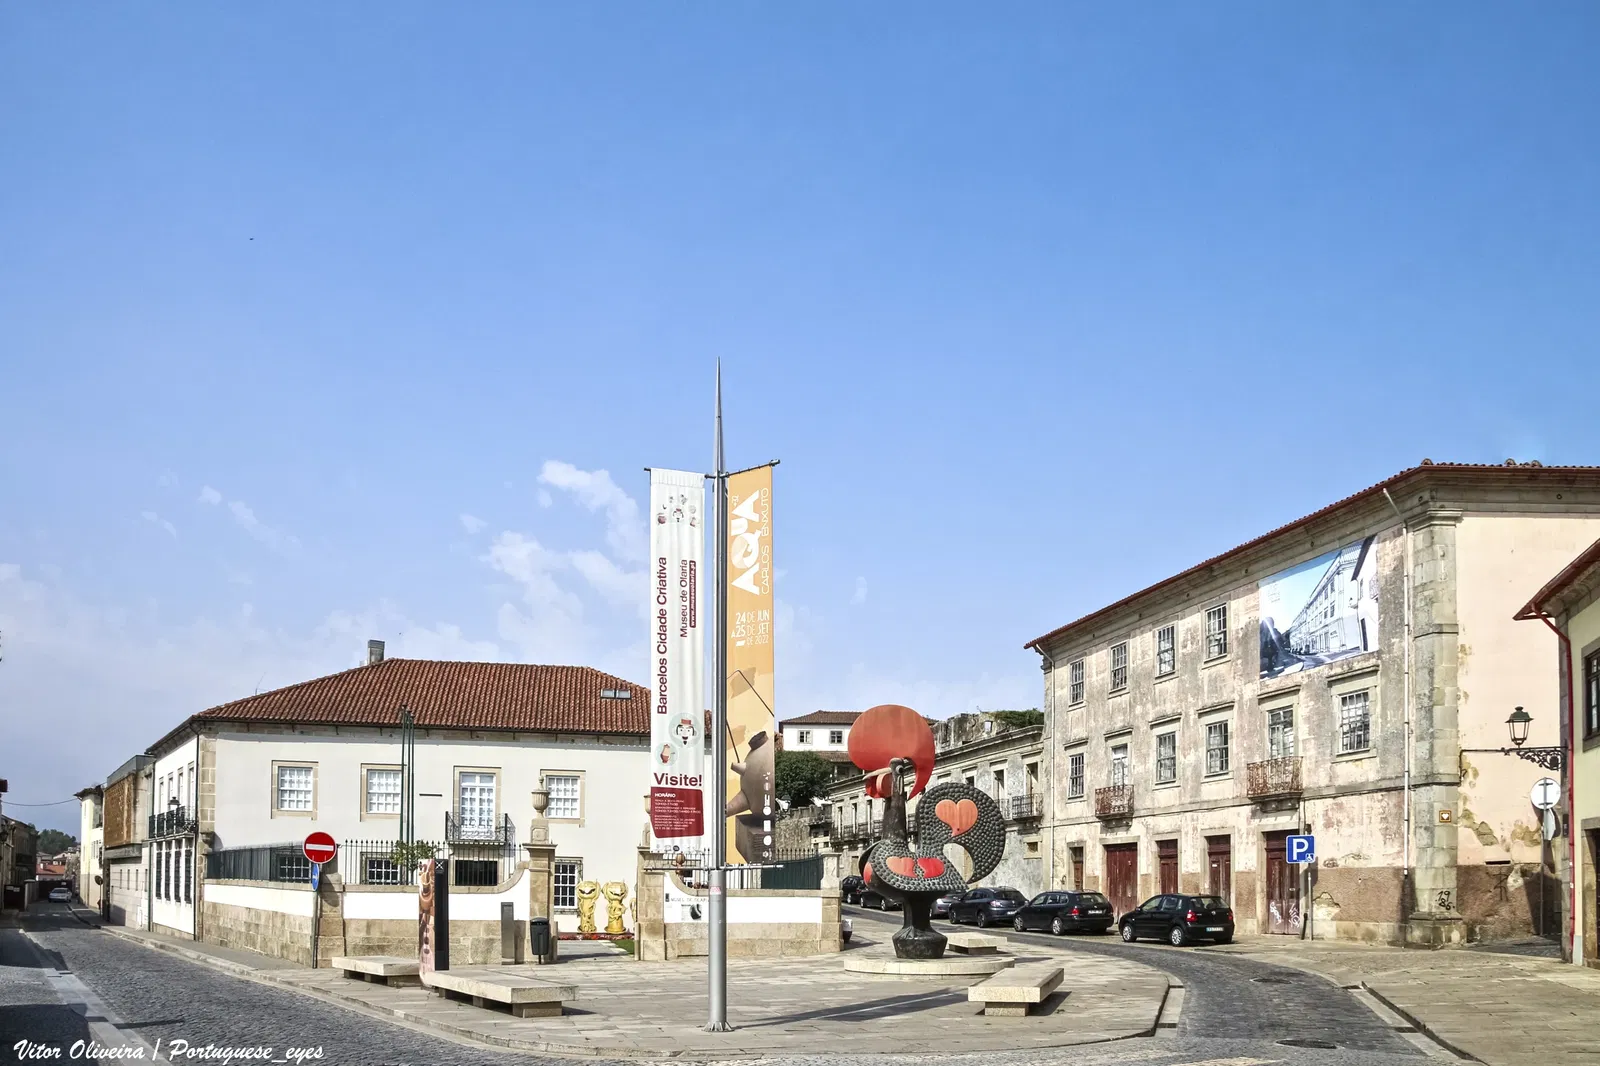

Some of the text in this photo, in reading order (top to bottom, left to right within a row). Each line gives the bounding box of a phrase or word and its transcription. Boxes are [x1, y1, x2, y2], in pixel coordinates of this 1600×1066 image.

[761, 545, 770, 595] CARLOS
[680, 559, 688, 638] Museu de Olaria
[735, 608, 770, 625] 24 DE JUN
[656, 557, 668, 715] Barcelos Cidade Criativa
[735, 624, 746, 638] 25
[746, 624, 756, 636] DE
[758, 622, 770, 635] SET
[754, 634, 769, 645] 2022
[653, 772, 703, 787] Visite!
[1292, 838, 1309, 861] P
